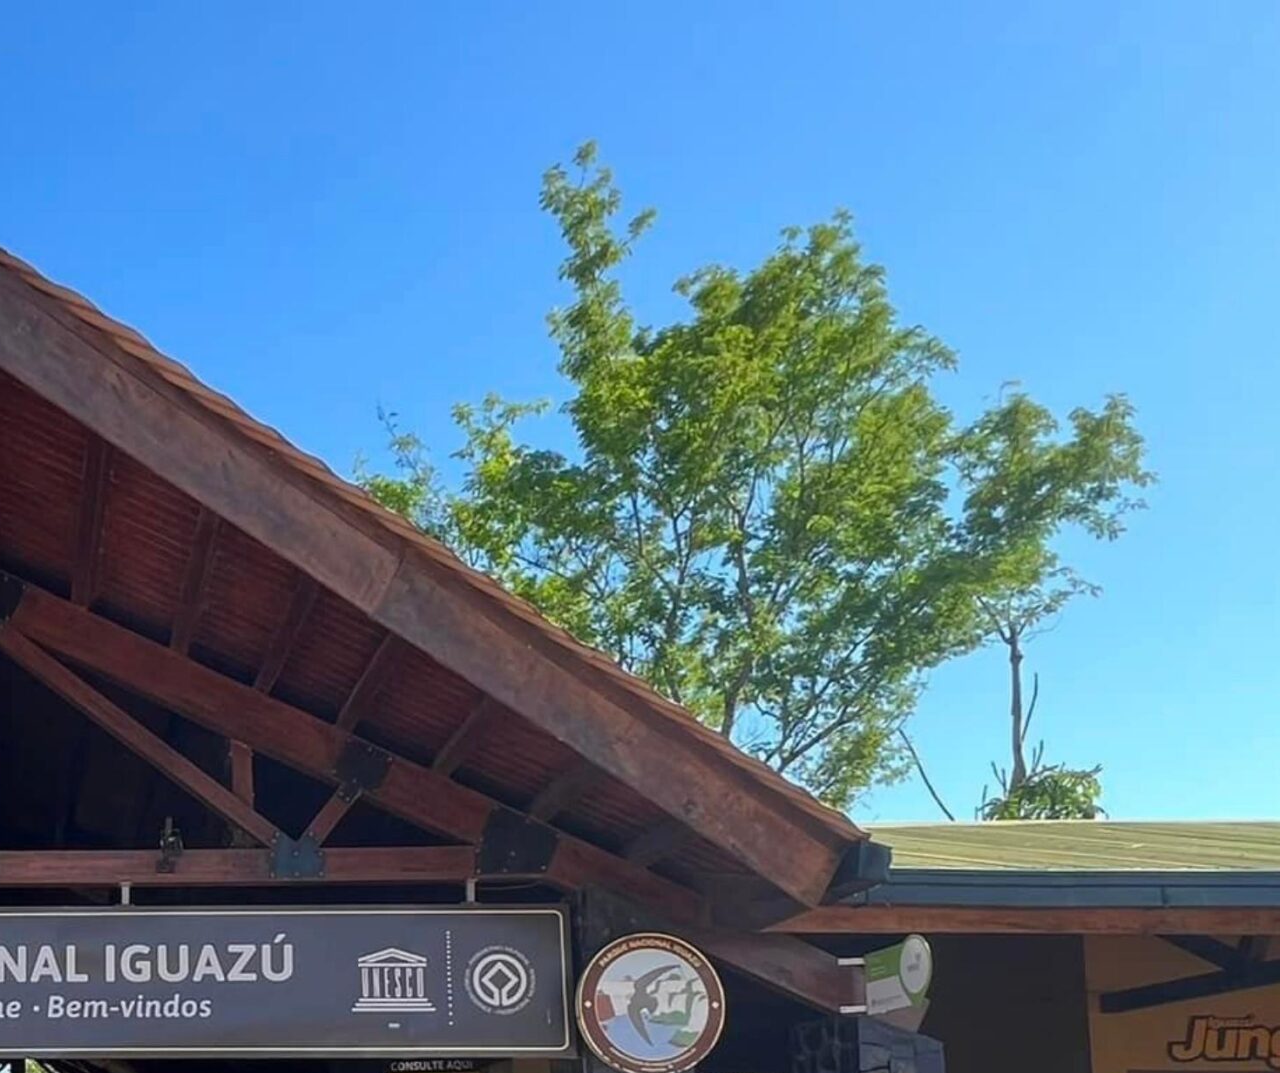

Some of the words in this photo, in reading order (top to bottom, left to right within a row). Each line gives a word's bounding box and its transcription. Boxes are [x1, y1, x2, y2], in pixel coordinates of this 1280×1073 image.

[105, 933, 295, 984] IGUAZÚ
[360, 967, 425, 998] UNESCO
[46, 993, 213, 1019] Bem-vindos
[1167, 1014, 1280, 1071] Jun
[391, 1060, 445, 1072] CONSULTE
